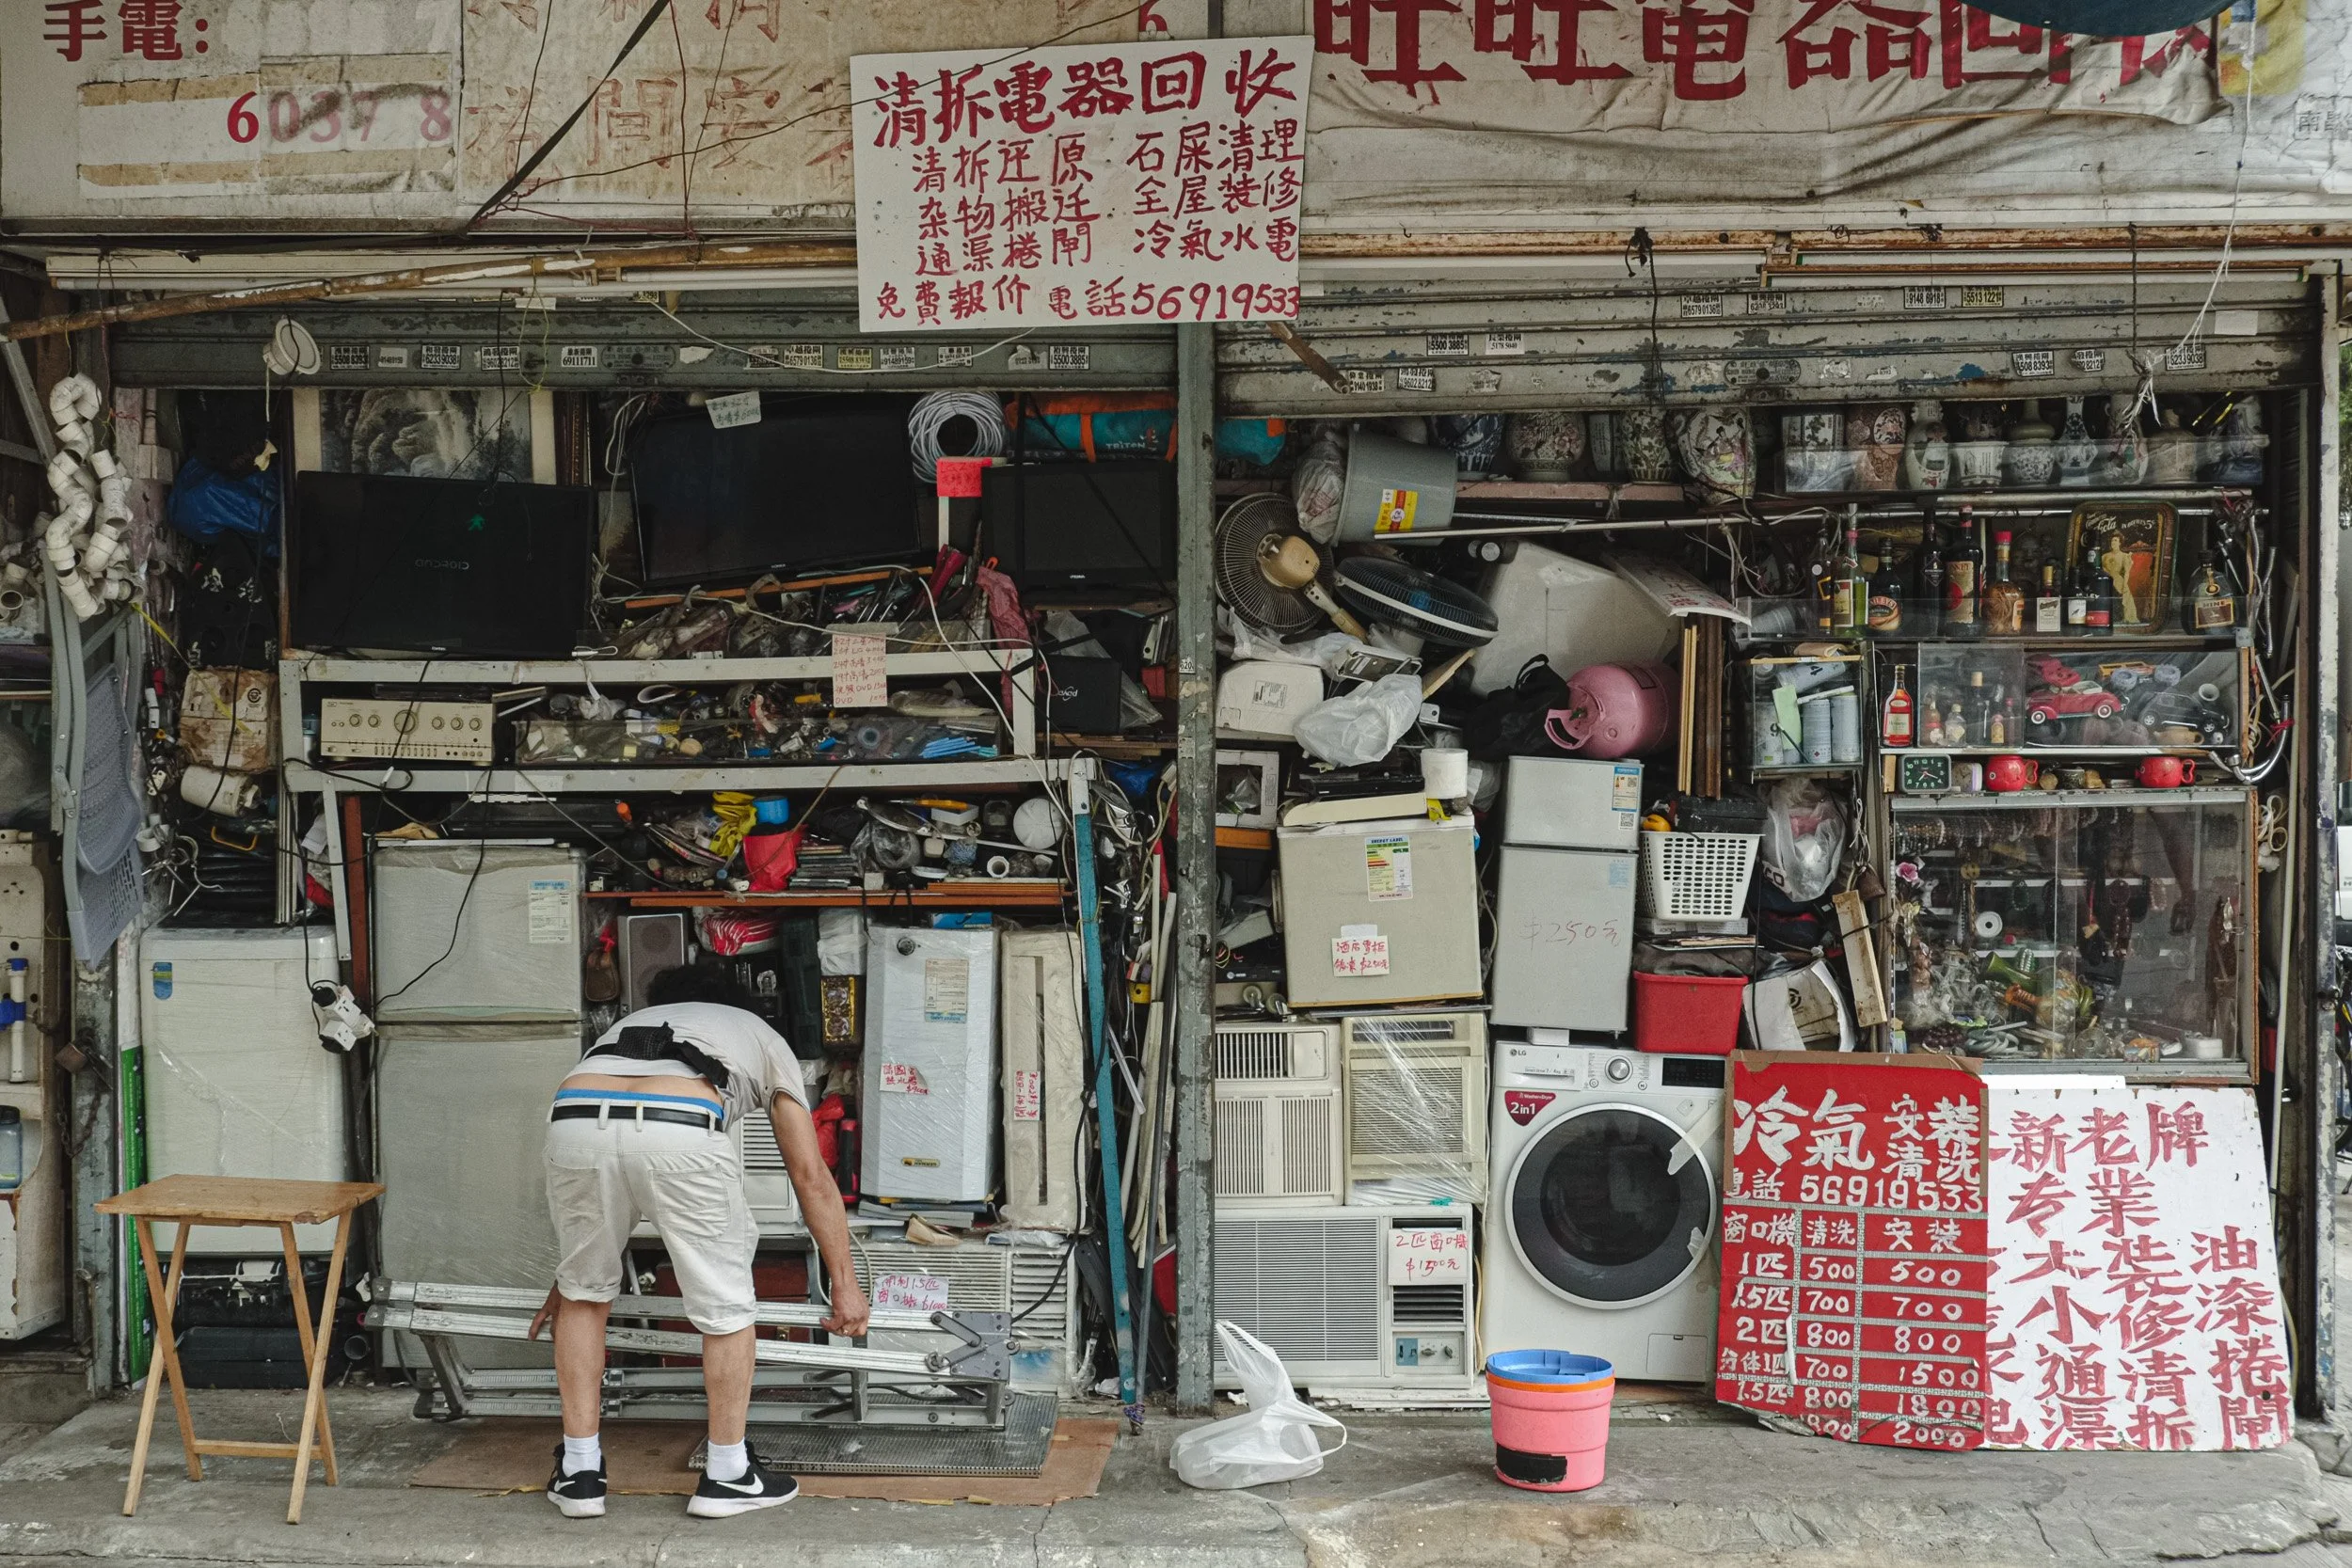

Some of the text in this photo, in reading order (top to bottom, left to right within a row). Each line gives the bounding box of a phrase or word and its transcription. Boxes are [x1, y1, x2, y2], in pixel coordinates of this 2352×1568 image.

[873, 48, 1298, 149] 清拆電器回收
[1126, 119, 1306, 179] 石屎清理
[1133, 214, 1299, 262] 冷氣水電
[563, 356, 596, 366] 69111711
[1733, 1085, 1875, 1173] 冷氣
[1800, 1175, 1984, 1213] 56919533
[1806, 1220, 1856, 1246] 清洗
[1739, 1252, 1962, 1287] 1匹 500 500
[1806, 1291, 1850, 1312] 700
[1897, 1296, 1963, 1321] 700
[1806, 1323, 1851, 1348] 800
[1895, 1326, 1961, 1354] 800
[1806, 1357, 1848, 1380] 700
[1899, 1364, 1979, 1390] 1500
[1804, 1386, 1851, 1410] 800
